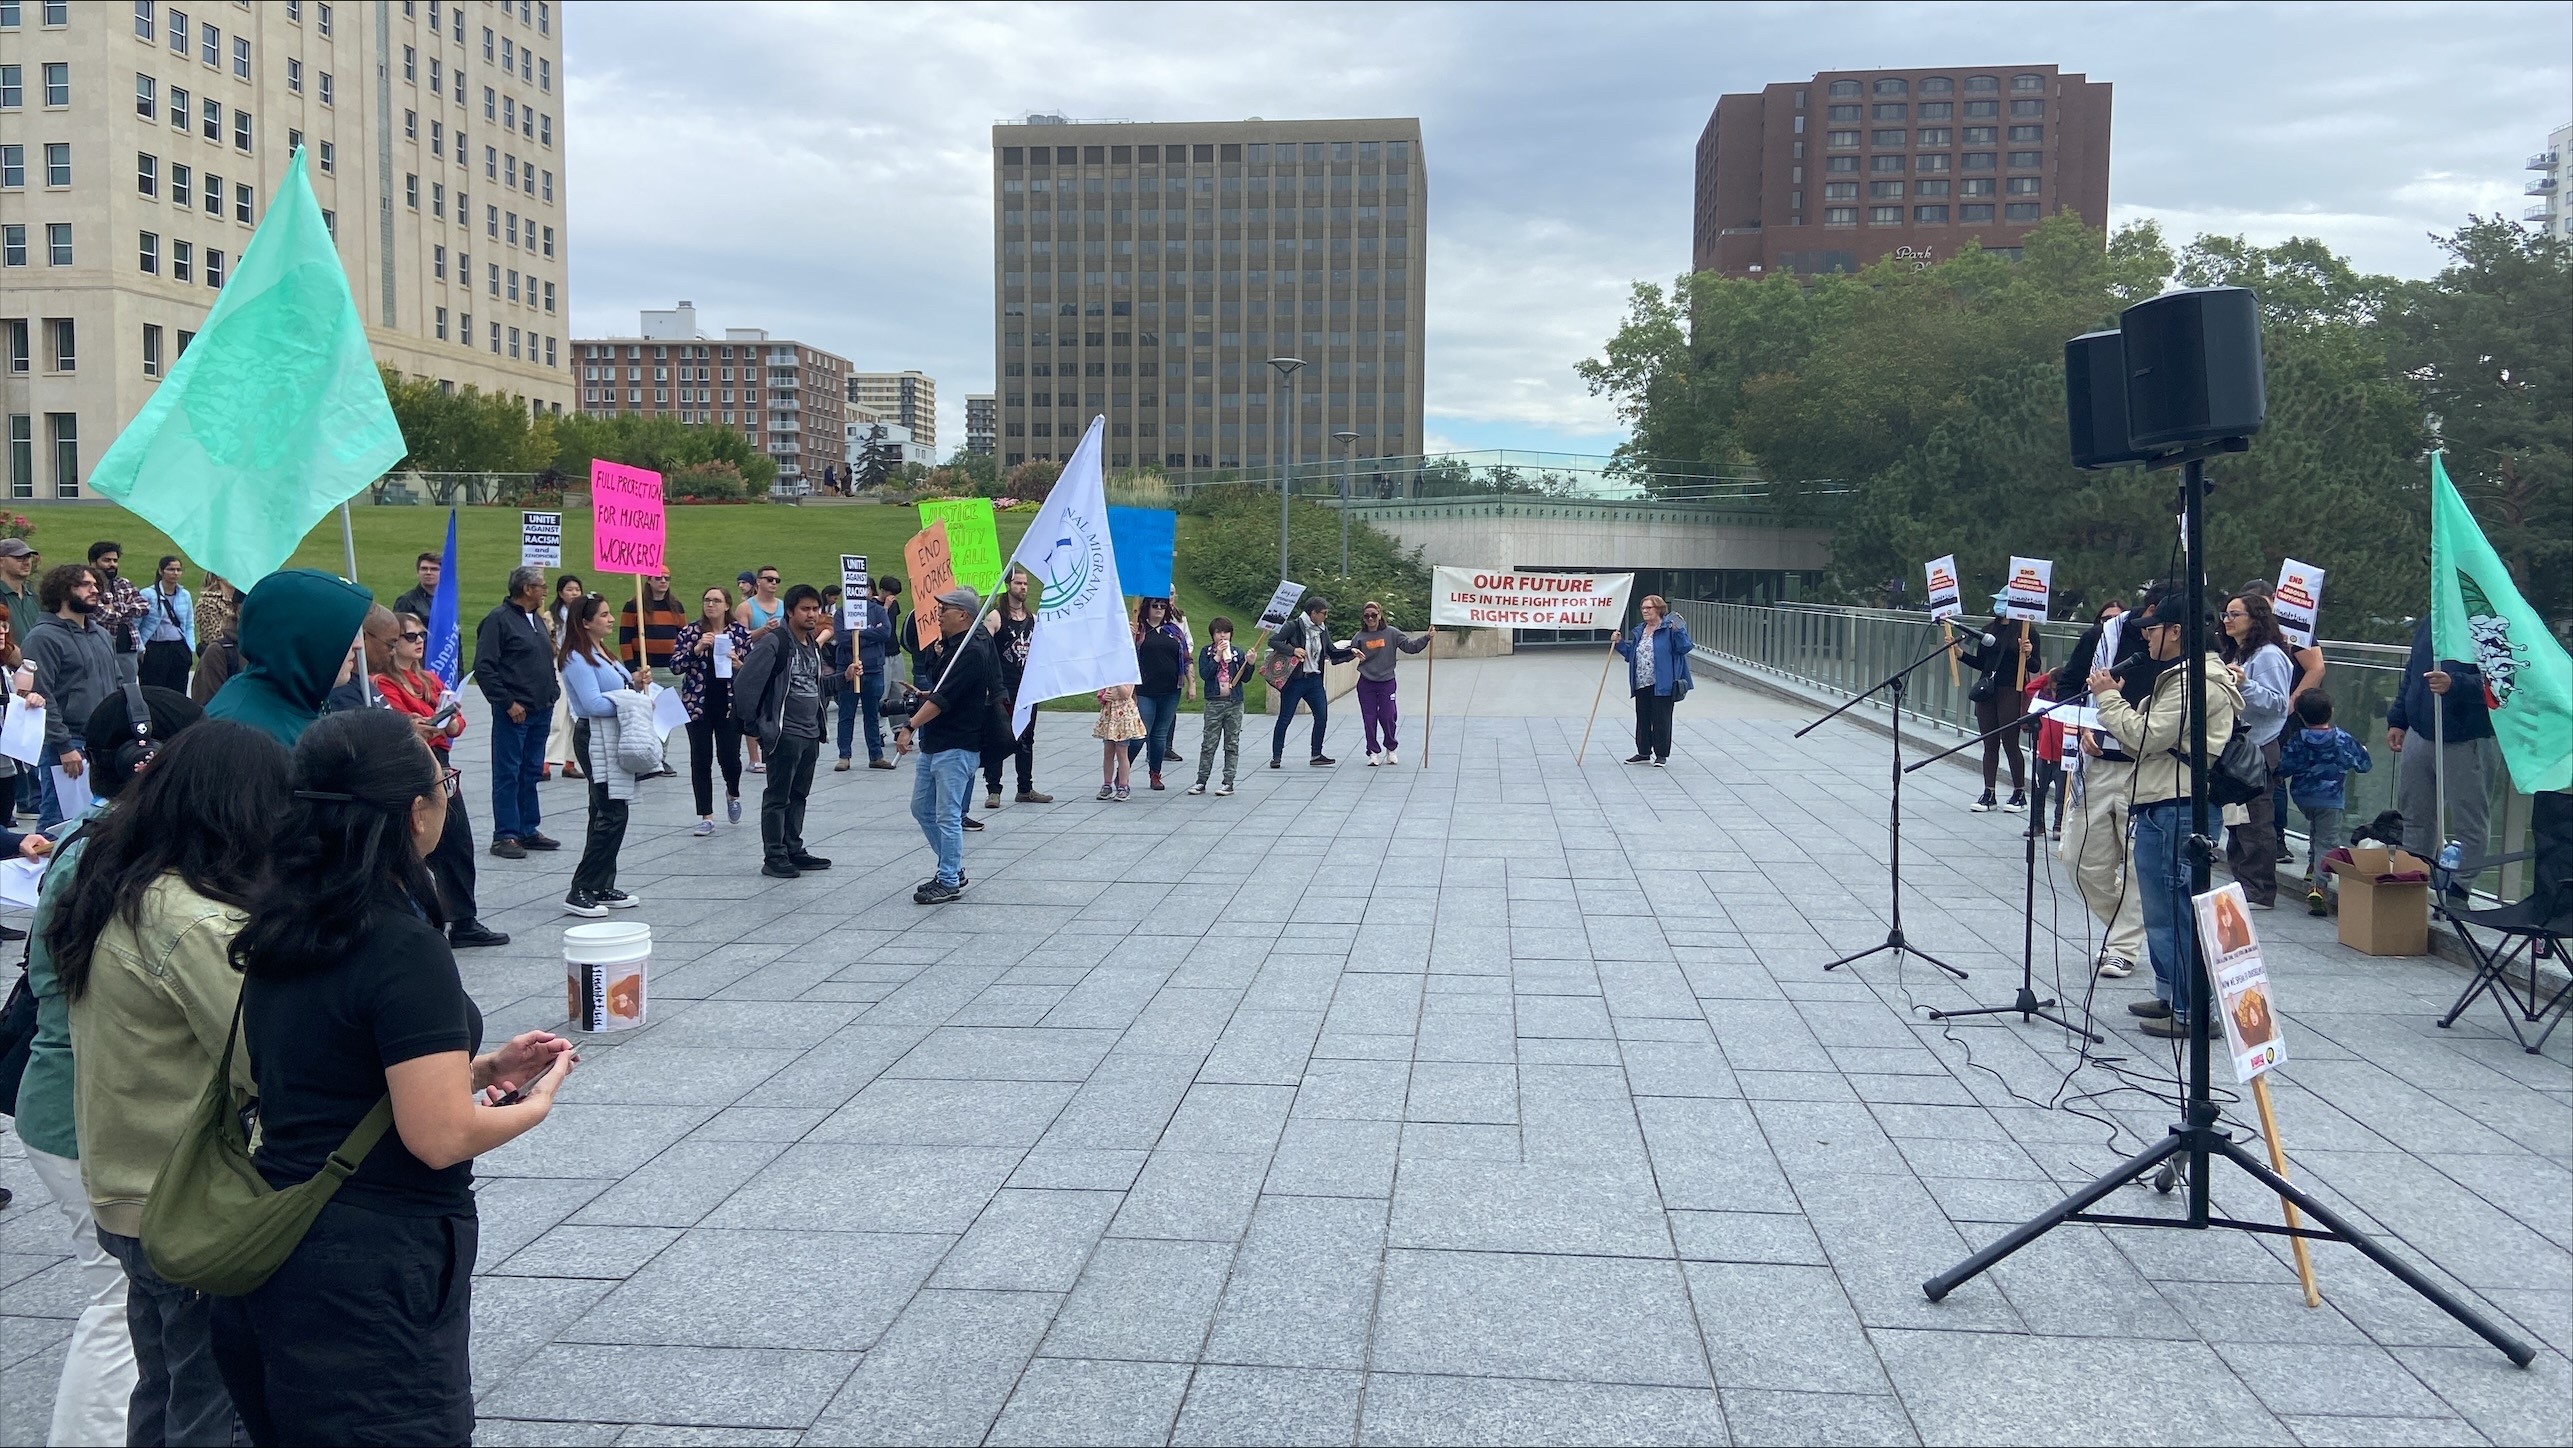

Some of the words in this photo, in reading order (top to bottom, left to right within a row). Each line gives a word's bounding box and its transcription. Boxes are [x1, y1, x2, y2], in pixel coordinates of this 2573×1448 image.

[1895, 245, 1932, 260] Park
[596, 471, 615, 491] FULL
[616, 475, 662, 501] PROTECTION
[529, 515, 556, 524] UNITE
[598, 505, 616, 526] FOR
[620, 508, 660, 531] MIGRANT
[924, 503, 979, 524] JUSTICE
[525, 535, 559, 544] RACISM
[950, 528, 986, 547] NITY
[600, 537, 662, 569] WORKERS!
[918, 539, 941, 568] END
[963, 548, 989, 565] ALL
[847, 559, 865, 570] UNITE
[1073, 533, 1104, 610] MIGRANTS
[1474, 574, 1515, 590] OUR
[1519, 577, 1594, 592] FUTURE
[2289, 575, 2303, 584] END
[854, 601, 862, 609] and
[1451, 592, 1476, 603] LIES
[1479, 595, 1492, 605] IN
[1495, 596, 1519, 606] THE
[1522, 597, 1559, 607] FIGHT
[1562, 598, 1587, 607] FOR
[1591, 597, 1612, 607] THE
[1470, 609, 1528, 623] RIGHTS
[1533, 612, 1555, 623] OF
[1559, 612, 1593, 625] ALL!
